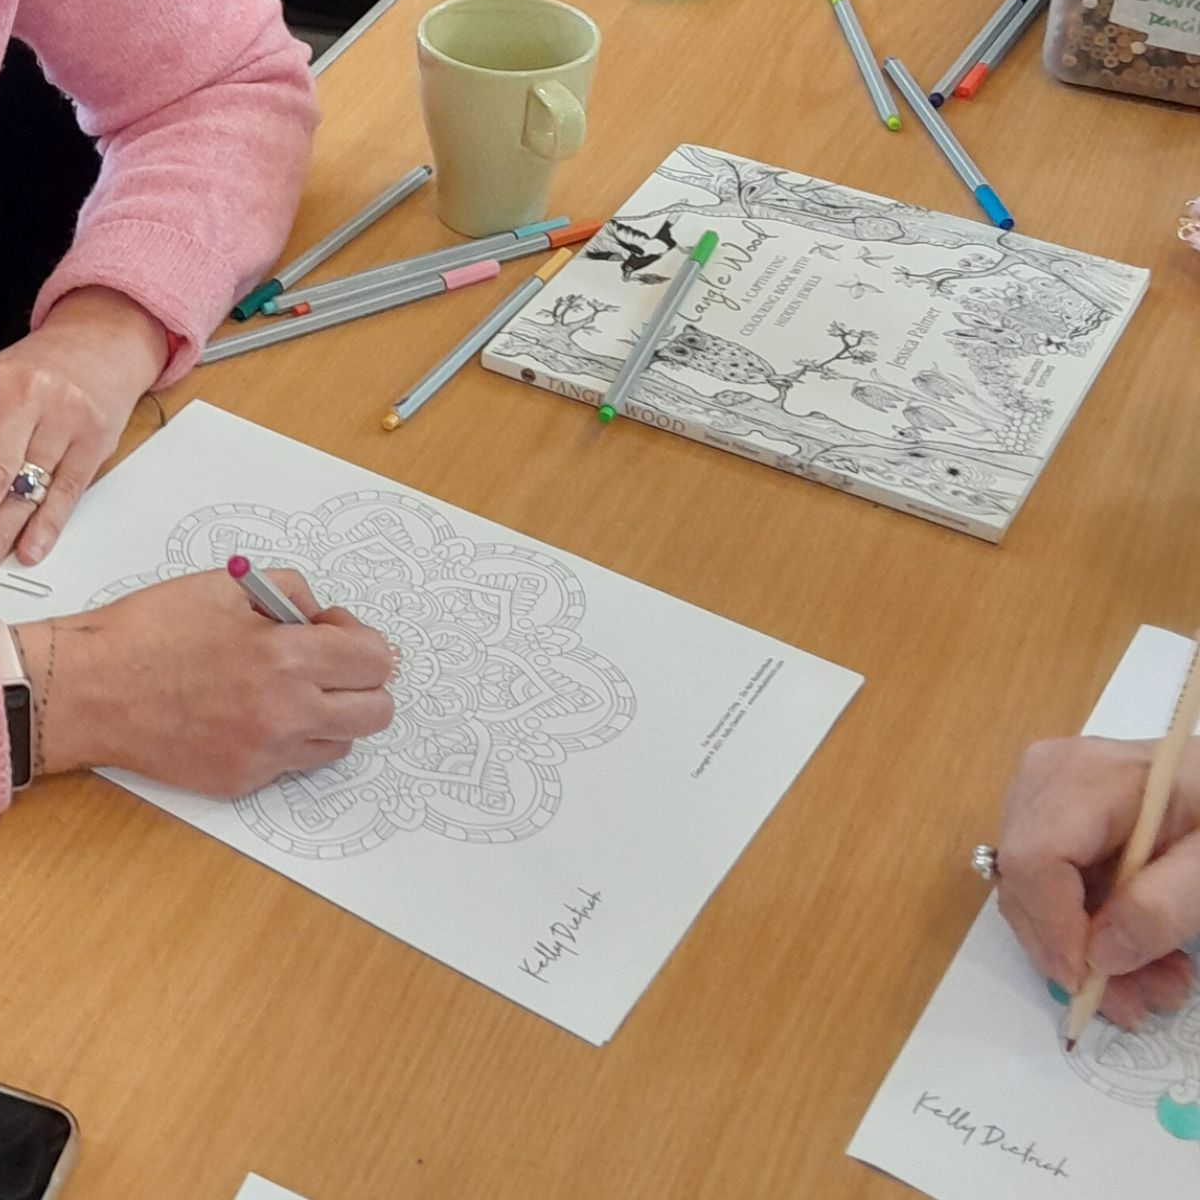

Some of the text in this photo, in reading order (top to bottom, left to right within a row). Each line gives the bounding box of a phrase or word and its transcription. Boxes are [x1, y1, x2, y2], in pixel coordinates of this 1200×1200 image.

[713, 220, 779, 272] Wood
[740, 256, 812, 336] COLOURING BOOK WITH
[745, 255, 787, 298] CAPTIVATING
[796, 274, 823, 301] JEWELS
[886, 306, 942, 371] Jessica Palmer
[546, 376, 686, 434] TANG WOOD
[518, 940, 579, 984] Kelly
[912, 1091, 978, 1144] Kelly
